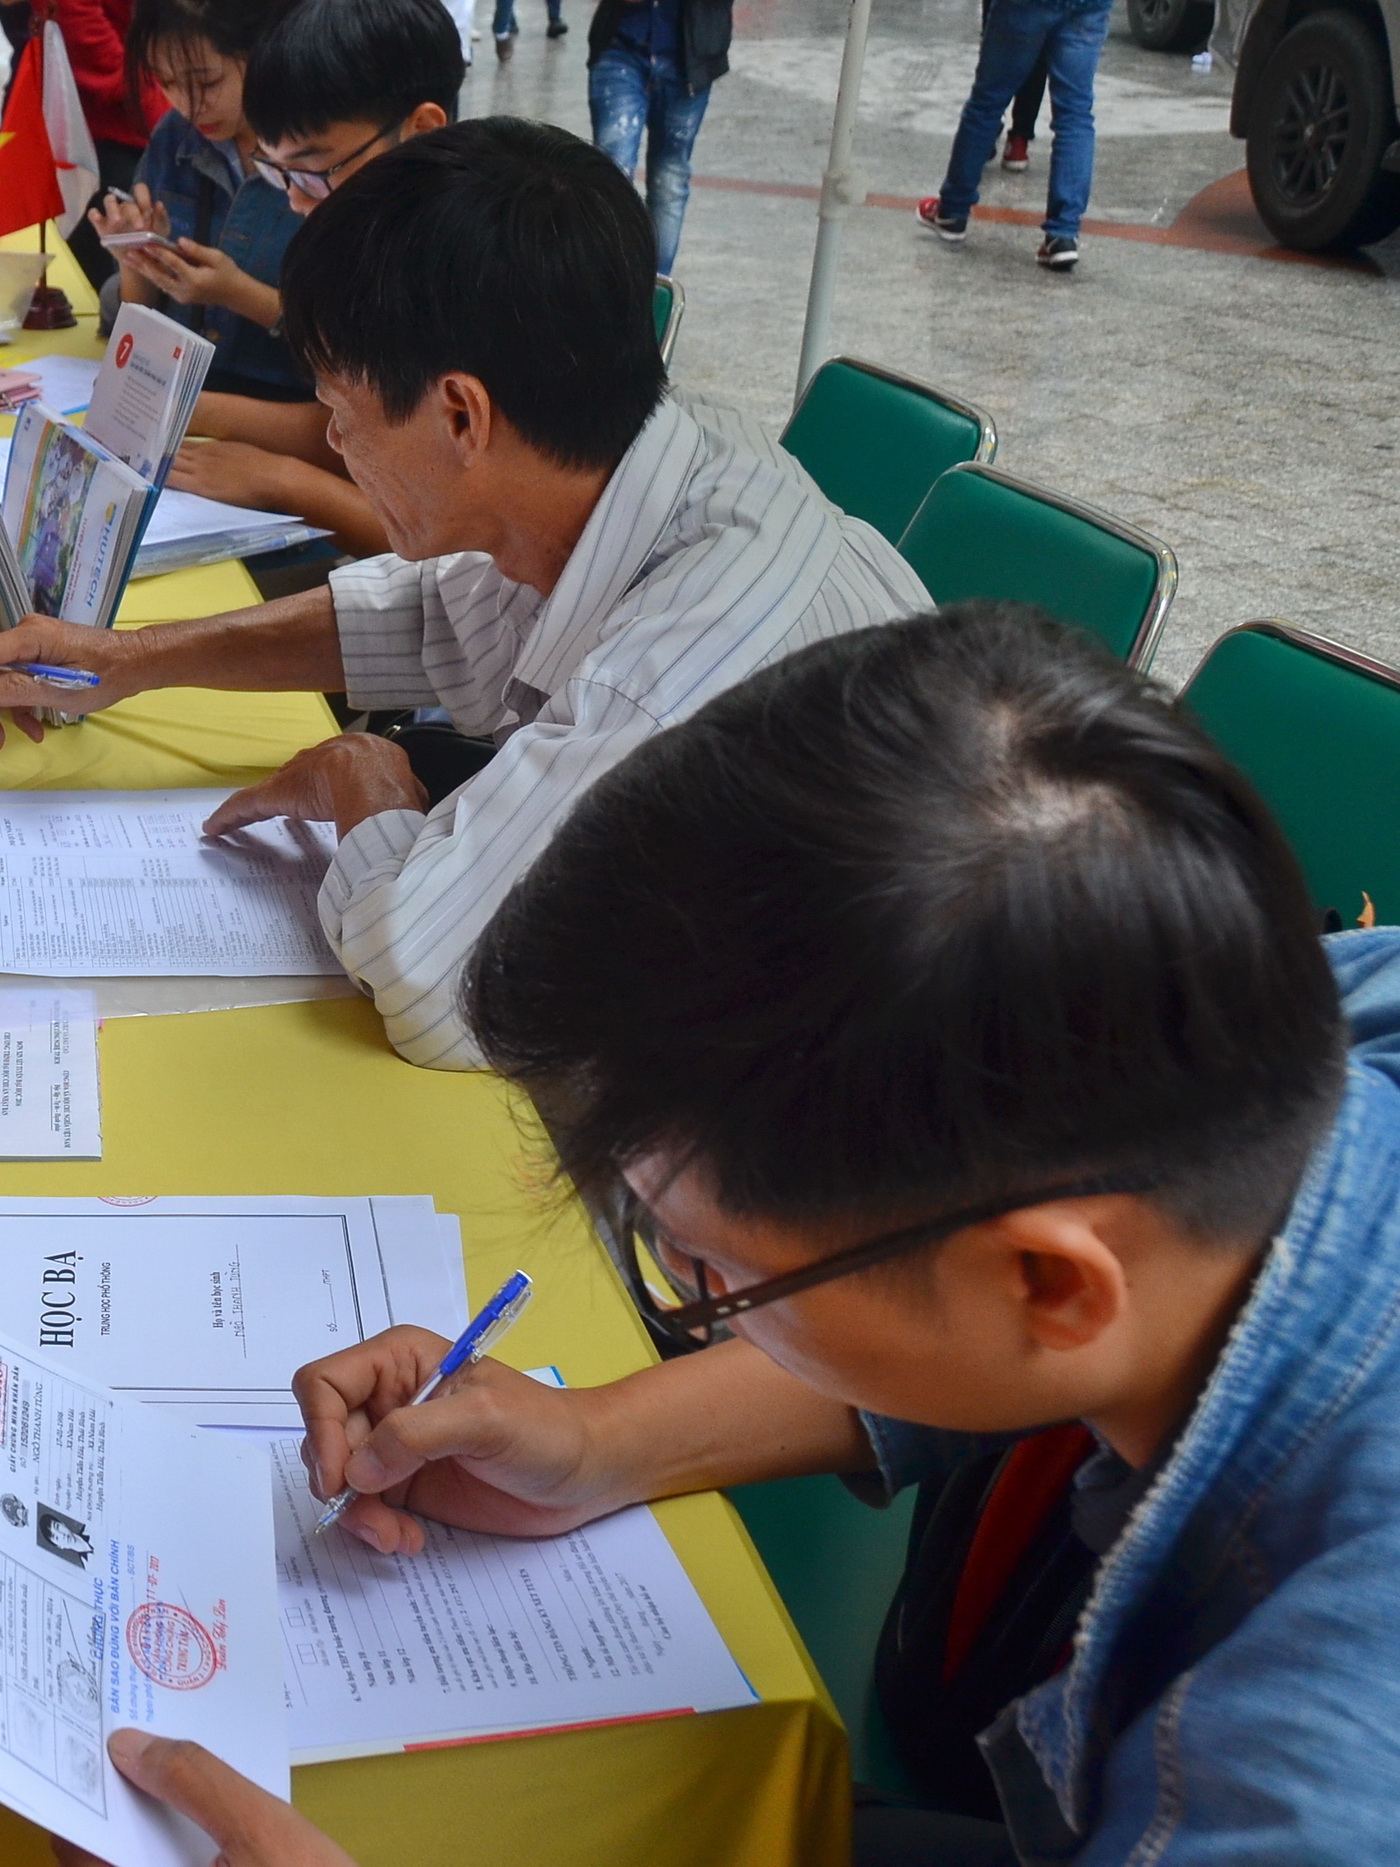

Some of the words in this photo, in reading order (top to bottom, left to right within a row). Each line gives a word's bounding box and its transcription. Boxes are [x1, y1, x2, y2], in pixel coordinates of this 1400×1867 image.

[86, 526, 111, 608] HUTECH
[43, 1250, 84, 1285] BẠ
[101, 1262, 111, 1284] THÔNG
[210, 1272, 221, 1284] sinh
[97, 1284, 110, 1298] PHỔ
[210, 1285, 223, 1296] học
[101, 1300, 112, 1312] HỌC
[211, 1298, 222, 1308] tên
[40, 1291, 82, 1348] HỌC
[100, 1314, 110, 1336] TRUNG
[212, 1319, 225, 1328] Họ
[12, 1365, 20, 1382] DÂN
[10, 1383, 19, 1403] NHÂN
[32, 1382, 44, 1408] TÙNG
[10, 1404, 18, 1426] MINH
[33, 1408, 42, 1440] THANH
[8, 1427, 18, 1453] CHỨNG
[8, 1455, 17, 1473] GIẤY
[32, 1442, 42, 1464] NGÔ
[108, 1540, 120, 1576] CHÍNH
[94, 1578, 105, 1610] THỰC
[108, 1579, 120, 1602] BẢN
[108, 1604, 120, 1622] VỚI
[91, 1615, 104, 1660] CHỨNG
[108, 1626, 120, 1659] ĐÚNG
[110, 1660, 120, 1686] SAO
[110, 1688, 120, 1714] BẢN
